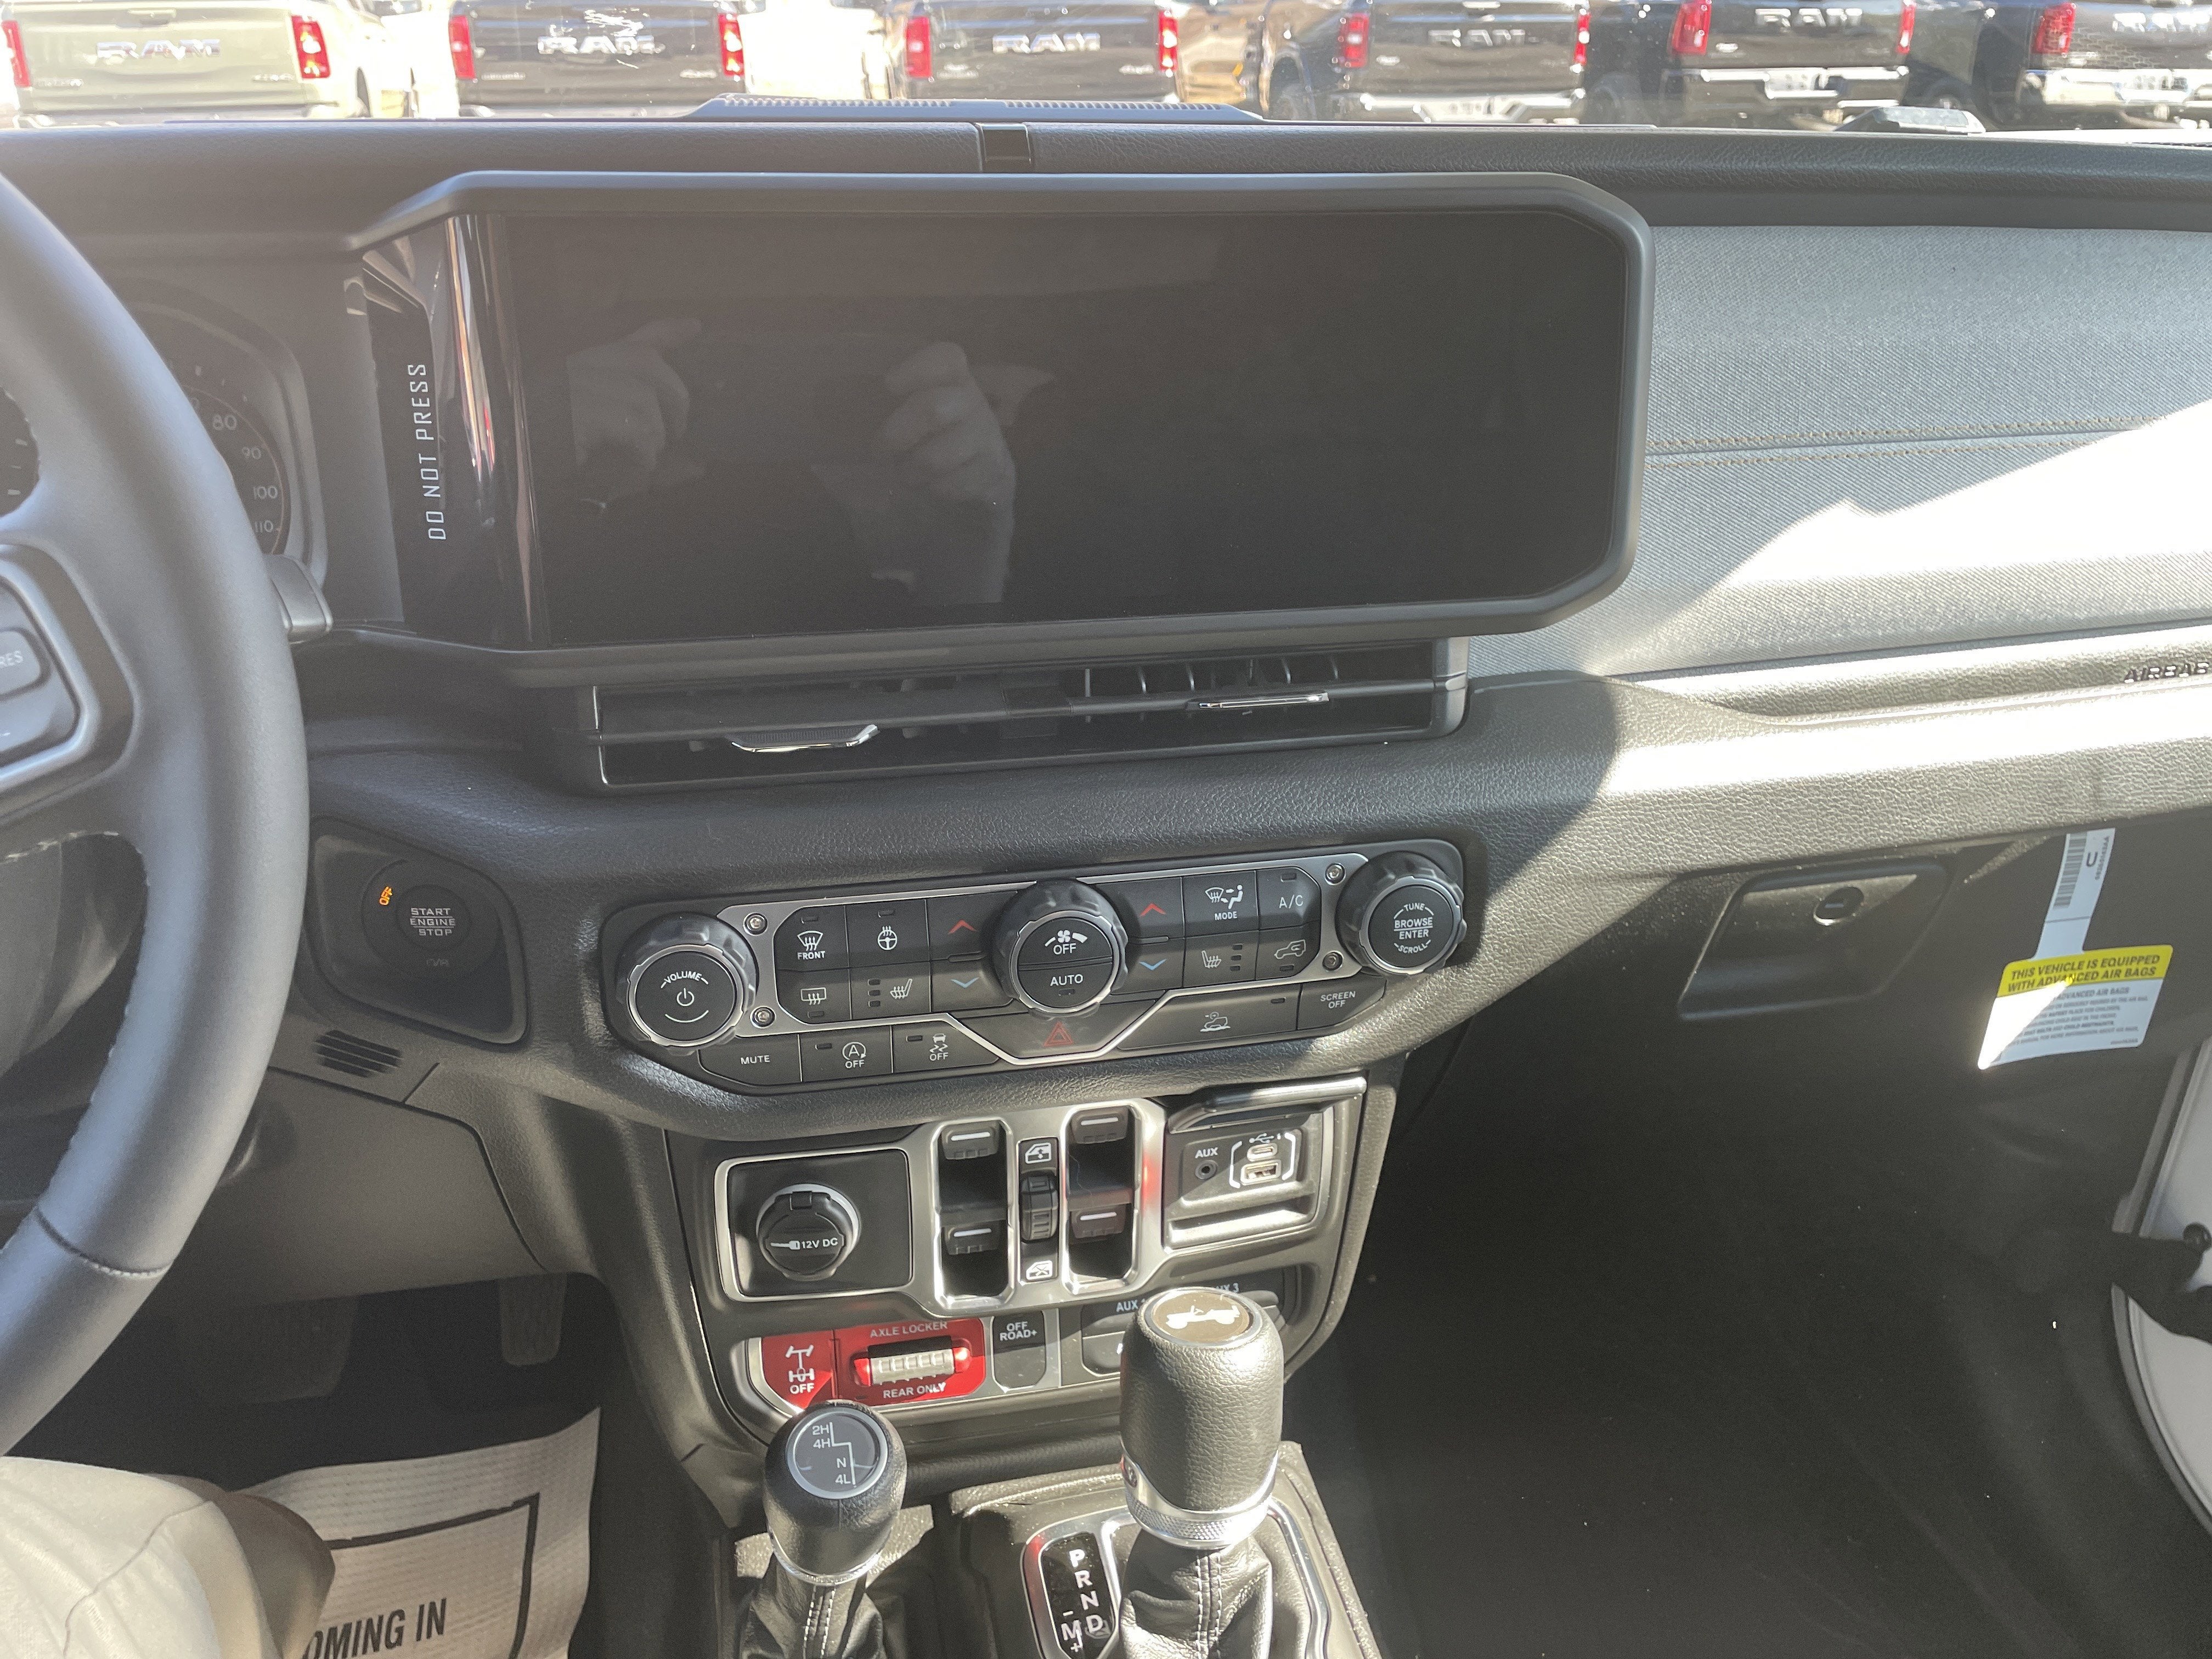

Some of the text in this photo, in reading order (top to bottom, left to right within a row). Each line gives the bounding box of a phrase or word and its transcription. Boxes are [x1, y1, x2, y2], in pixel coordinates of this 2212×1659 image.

[95, 39, 219, 60] RAM
[538, 36, 655, 55] RAM
[992, 33, 1101, 54] RAM
[212, 414, 238, 431] 80
[241, 447, 262, 460] 90
[408, 363, 447, 540] DO NOT PRESS
[253, 485, 279, 500] 100
[254, 520, 274, 533] 110
[1279, 895, 1304, 909] A/C
[1403, 902, 1425, 911] TUNE
[410, 907, 451, 916] START
[1214, 911, 1238, 921] MODE
[409, 918, 456, 926] ENGINE
[1394, 917, 1433, 929] BROWSE
[1399, 929, 1429, 940] ENTER
[1053, 943, 1076, 955] OFF
[1398, 943, 1427, 953] SCROLL
[797, 950, 826, 960] FRONT
[2011, 955, 2160, 980] THIS VEHICLE IS EQUIPPED
[664, 972, 703, 983] VOLUME
[1050, 974, 1084, 986] AUTO
[2008, 978, 2034, 992] WITH
[2101, 969, 2122, 980] AIR
[2125, 967, 2157, 977] BAGS
[1321, 991, 1356, 1002] SCREEN
[1328, 1000, 1345, 1009] OFF
[741, 1054, 770, 1064] MUTE
[929, 1052, 949, 1062] OFF
[845, 1059, 865, 1069] OFF
[1195, 1147, 1218, 1159] AUX
[801, 1238, 838, 1250] 12V DC
[1116, 1299, 1139, 1312] AUX
[870, 1321, 948, 1338] AXLE LOCKER
[1006, 1322, 1028, 1332] OFF
[789, 1383, 814, 1395] OFF
[883, 1383, 946, 1398] REAR ONLY
[812, 1424, 830, 1435] 2H
[813, 1438, 831, 1449] 4H
[836, 1457, 847, 1469] N
[835, 1474, 851, 1485] 4L
[1069, 1549, 1085, 1568] P
[1074, 1570, 1093, 1588] R
[1080, 1590, 1099, 1610] N
[302, 1598, 447, 1659] OMING IN
[1086, 1614, 1103, 1633] D
[1060, 1620, 1082, 1641] M
